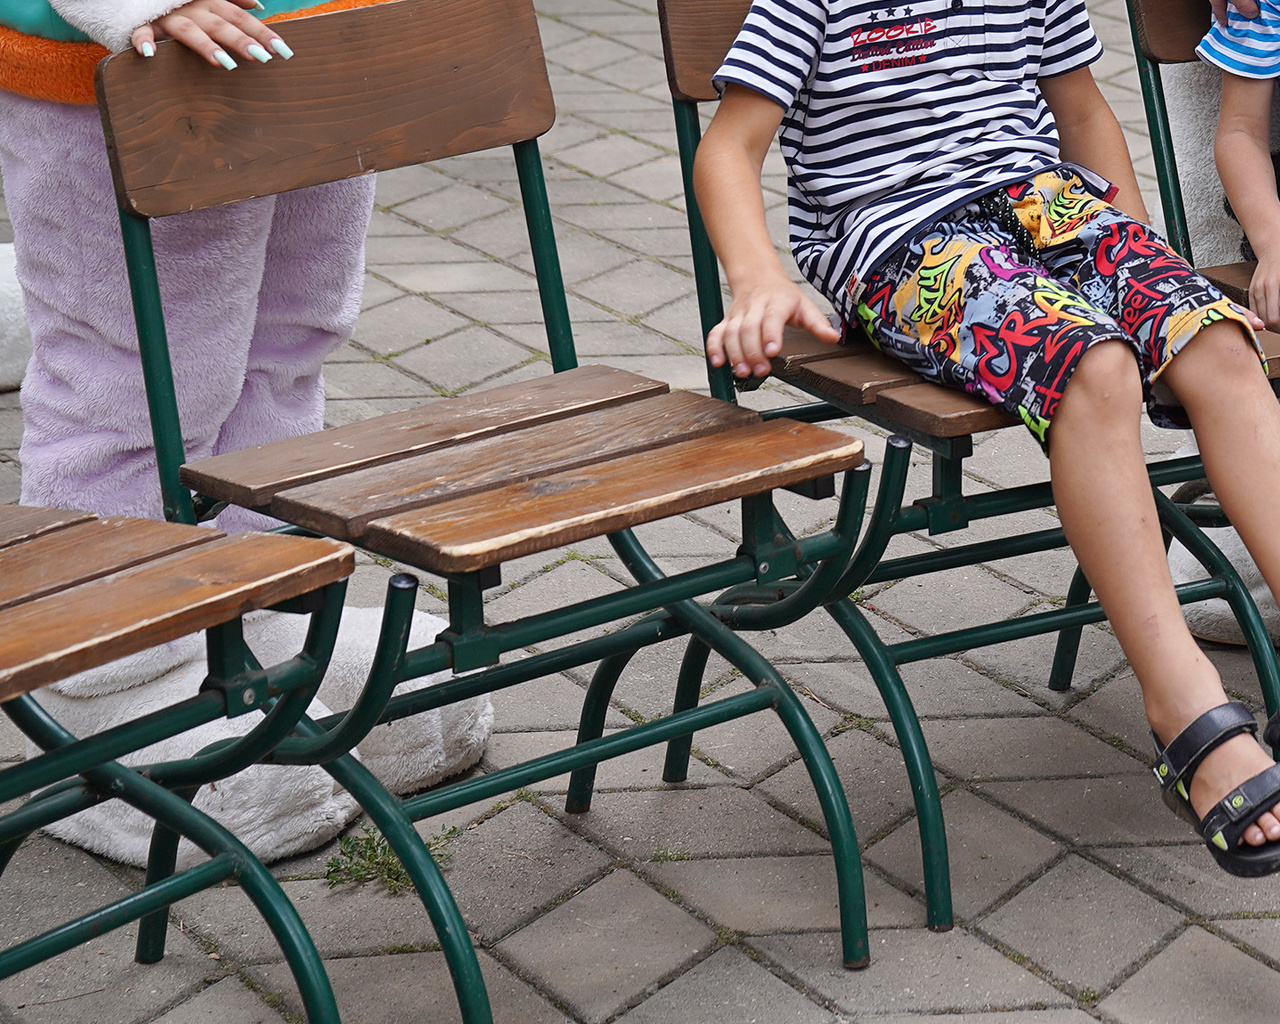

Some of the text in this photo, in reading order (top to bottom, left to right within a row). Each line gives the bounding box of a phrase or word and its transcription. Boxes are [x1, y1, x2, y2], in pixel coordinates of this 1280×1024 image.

[850, 17, 937, 47] ROOKIE
[850, 38, 937, 62] Limited Edition
[872, 55, 916, 71] DENIM
